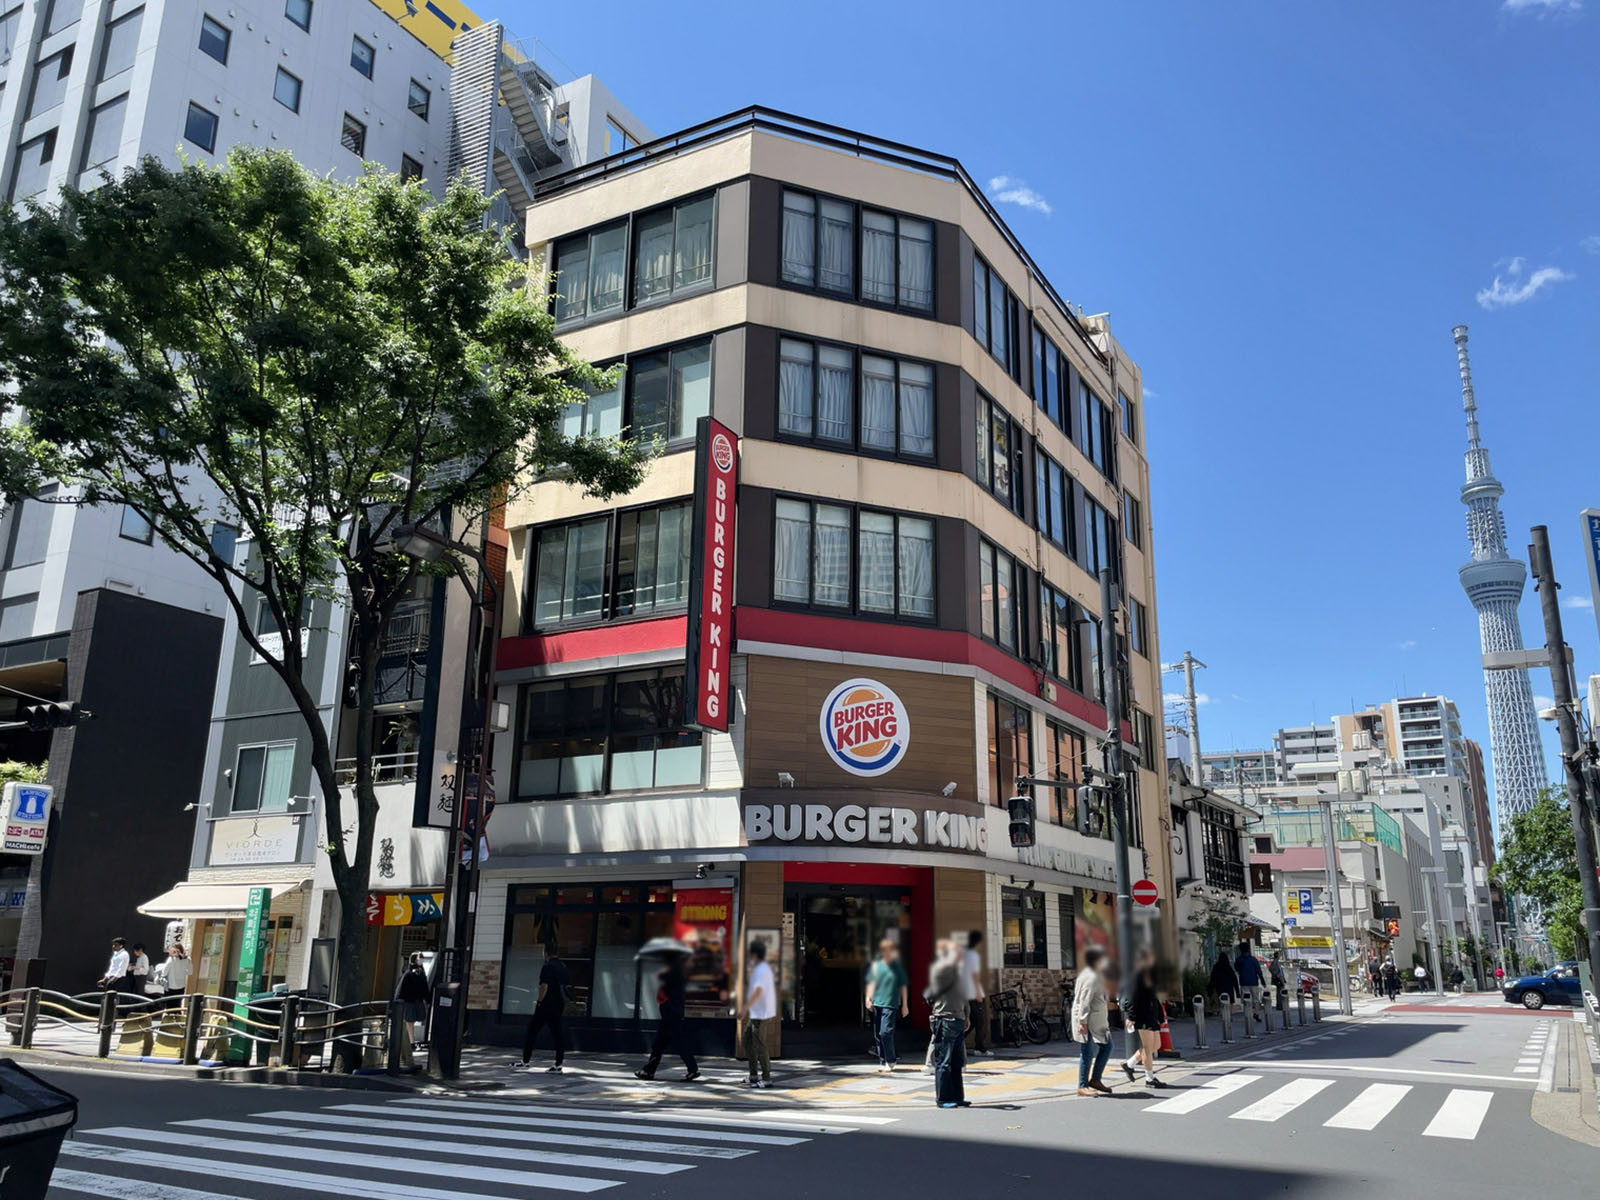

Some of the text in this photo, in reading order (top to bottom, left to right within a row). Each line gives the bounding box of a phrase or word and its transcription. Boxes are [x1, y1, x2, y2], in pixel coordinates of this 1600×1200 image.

[706, 478, 727, 719] BURGER KING
[834, 701, 895, 729] BURGER
[836, 716, 898, 751] KING
[30, 829, 44, 837] ATM
[745, 804, 989, 853] BURGER KING
[226, 839, 283, 849] VIORDE
[1300, 892, 1311, 905] P
[681, 905, 728, 920] STRONG
